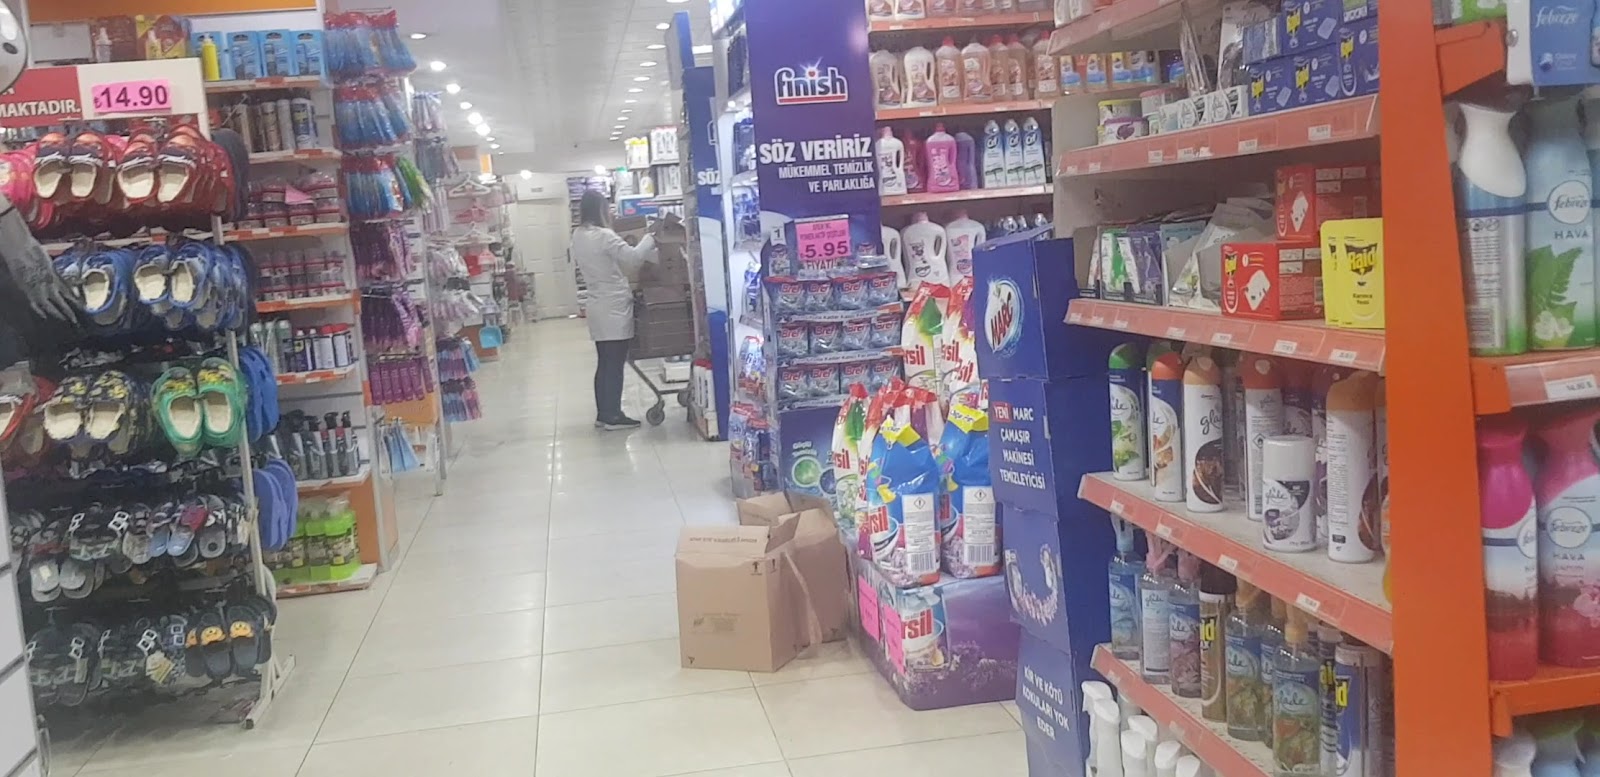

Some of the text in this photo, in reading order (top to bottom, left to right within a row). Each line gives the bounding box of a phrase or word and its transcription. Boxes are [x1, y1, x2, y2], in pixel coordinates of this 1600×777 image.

[777, 67, 847, 99] finish
[760, 133, 873, 164] SÖZ VERİRİZ
[778, 160, 874, 179] MÜKEMMEL TEMİZLİK
[809, 176, 876, 193] VE PARLAKLIĞA
[1554, 229, 1589, 239] HAVA
[1348, 244, 1377, 271] Raid
[904, 344, 925, 366] rsil
[994, 403, 1034, 421] YENİ MARC
[1200, 408, 1221, 436] gla
[1000, 428, 1031, 445] ÇAMAŞIR
[832, 448, 851, 470] rsil
[1002, 447, 1034, 466] MAKİNESİ
[1000, 467, 1046, 490] TEMİZLEYİCİSİ
[869, 505, 889, 534] rsil
[901, 608, 933, 640] rsil
[1044, 680, 1064, 706] KÖTÜ
[1036, 715, 1056, 741] EDER
[1053, 708, 1070, 732] YOK
